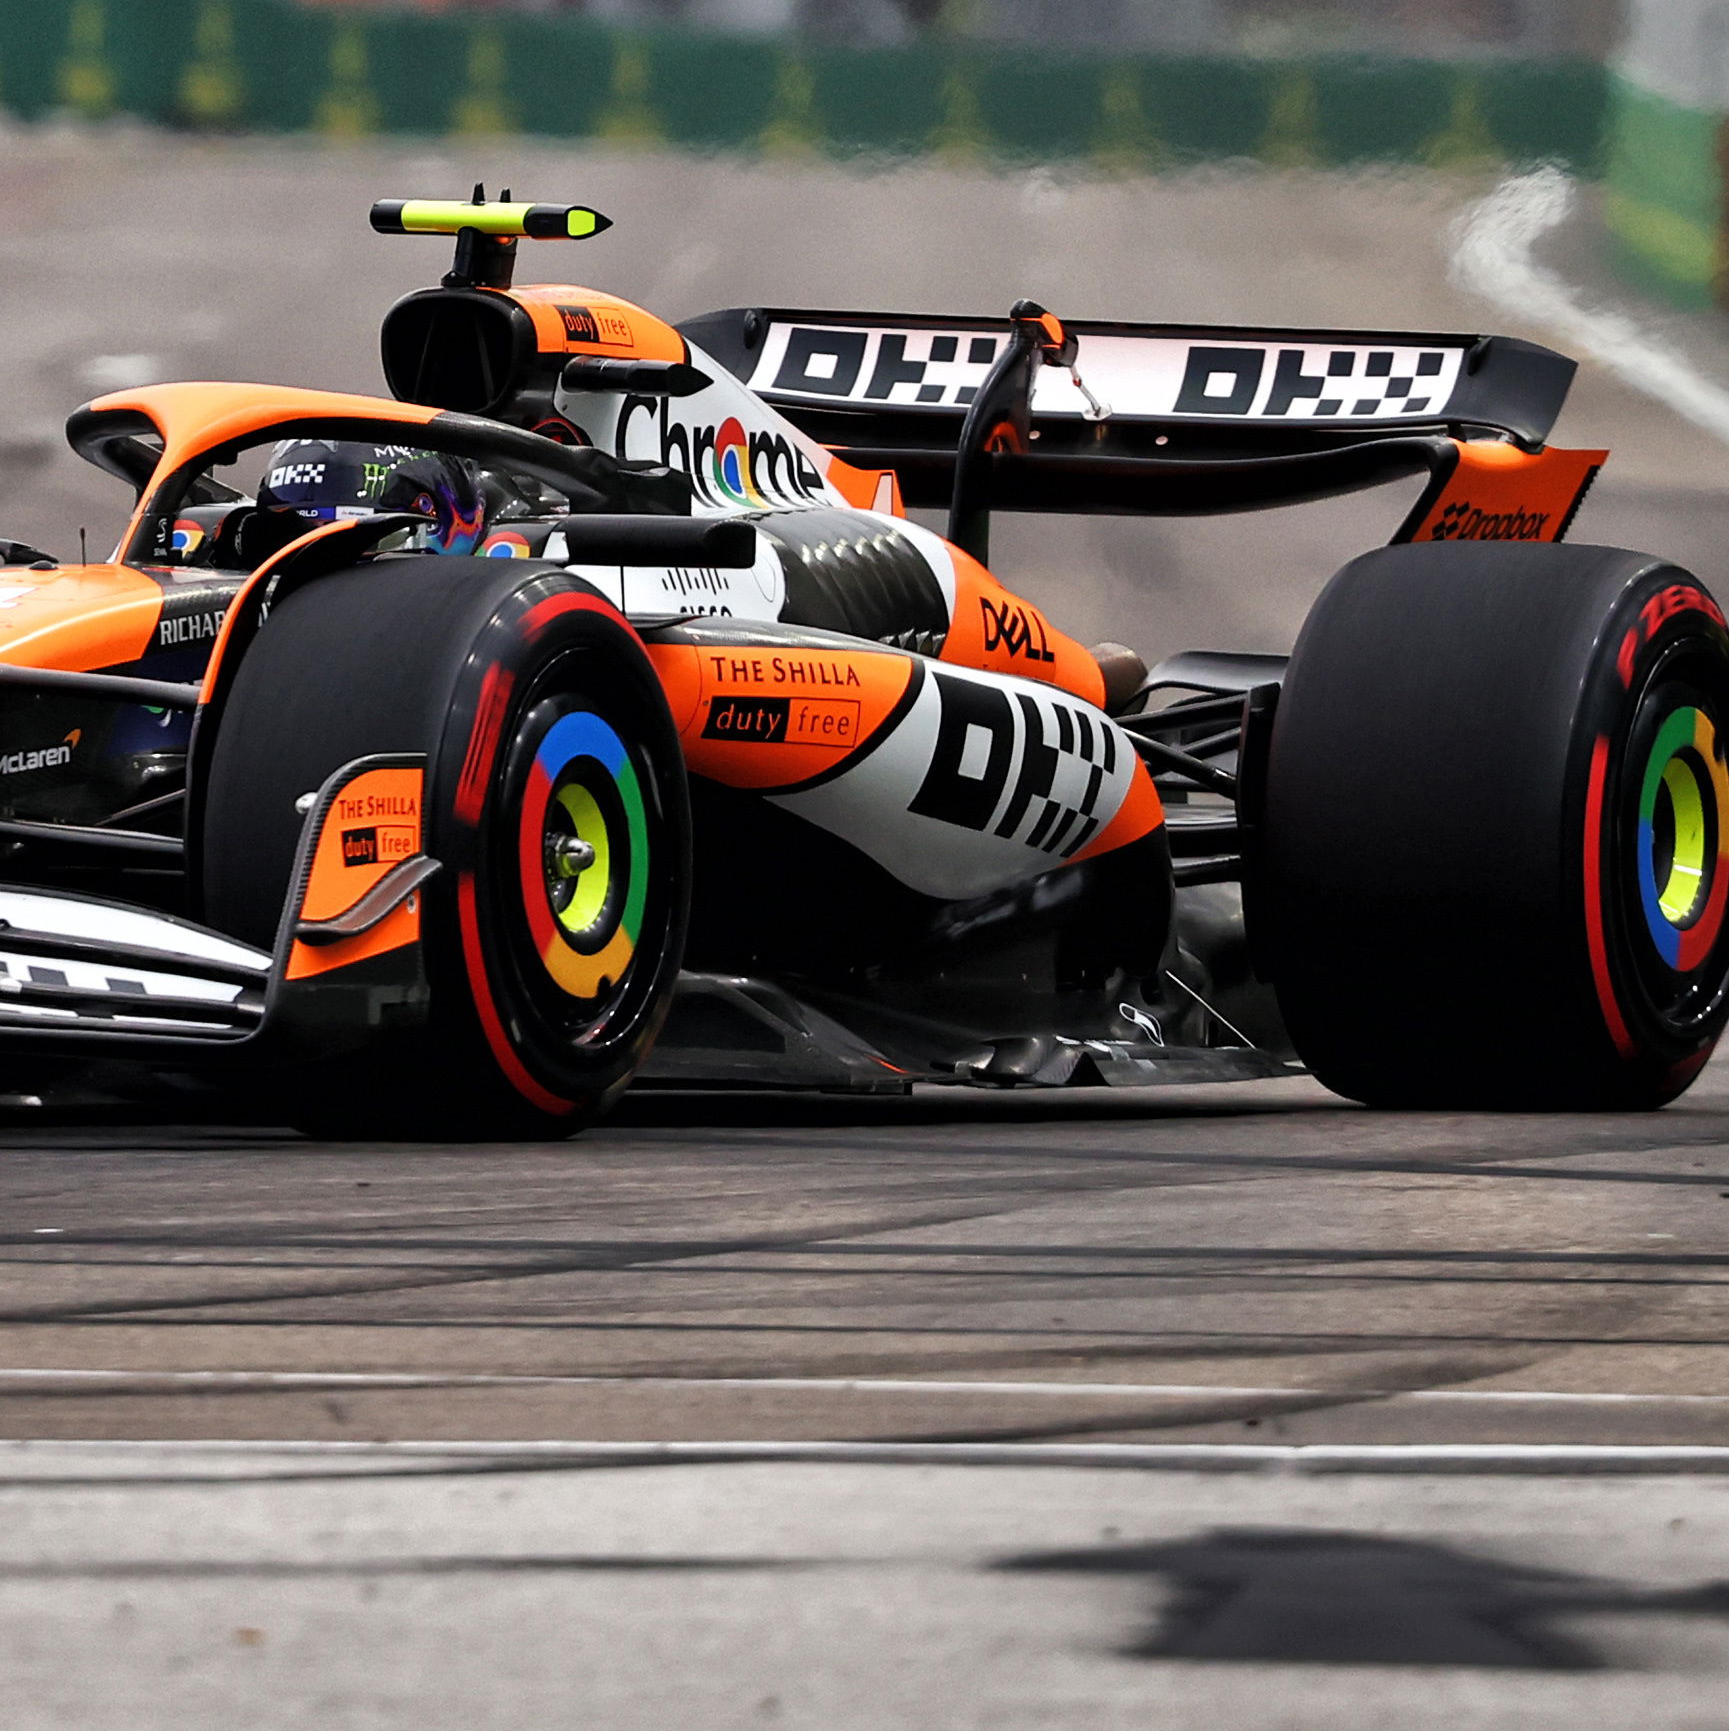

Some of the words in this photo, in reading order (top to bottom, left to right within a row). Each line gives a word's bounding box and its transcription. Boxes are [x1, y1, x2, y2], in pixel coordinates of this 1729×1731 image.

[564, 309, 595, 340] duty
[597, 312, 628, 336] free
[1172, 346, 1445, 416] OKX
[615, 393, 834, 509] Chrome
[268, 463, 326, 489] OKX
[1457, 504, 1550, 540] Dropbox
[979, 596, 1054, 663] DELL
[709, 656, 765, 683] THE
[771, 657, 861, 687] SHILLA
[716, 703, 782, 740] duty
[798, 705, 850, 736] free
[907, 670, 1116, 858] OKX
[338, 798, 364, 820] THE
[367, 795, 417, 817] SHILLA
[381, 830, 411, 854] free
